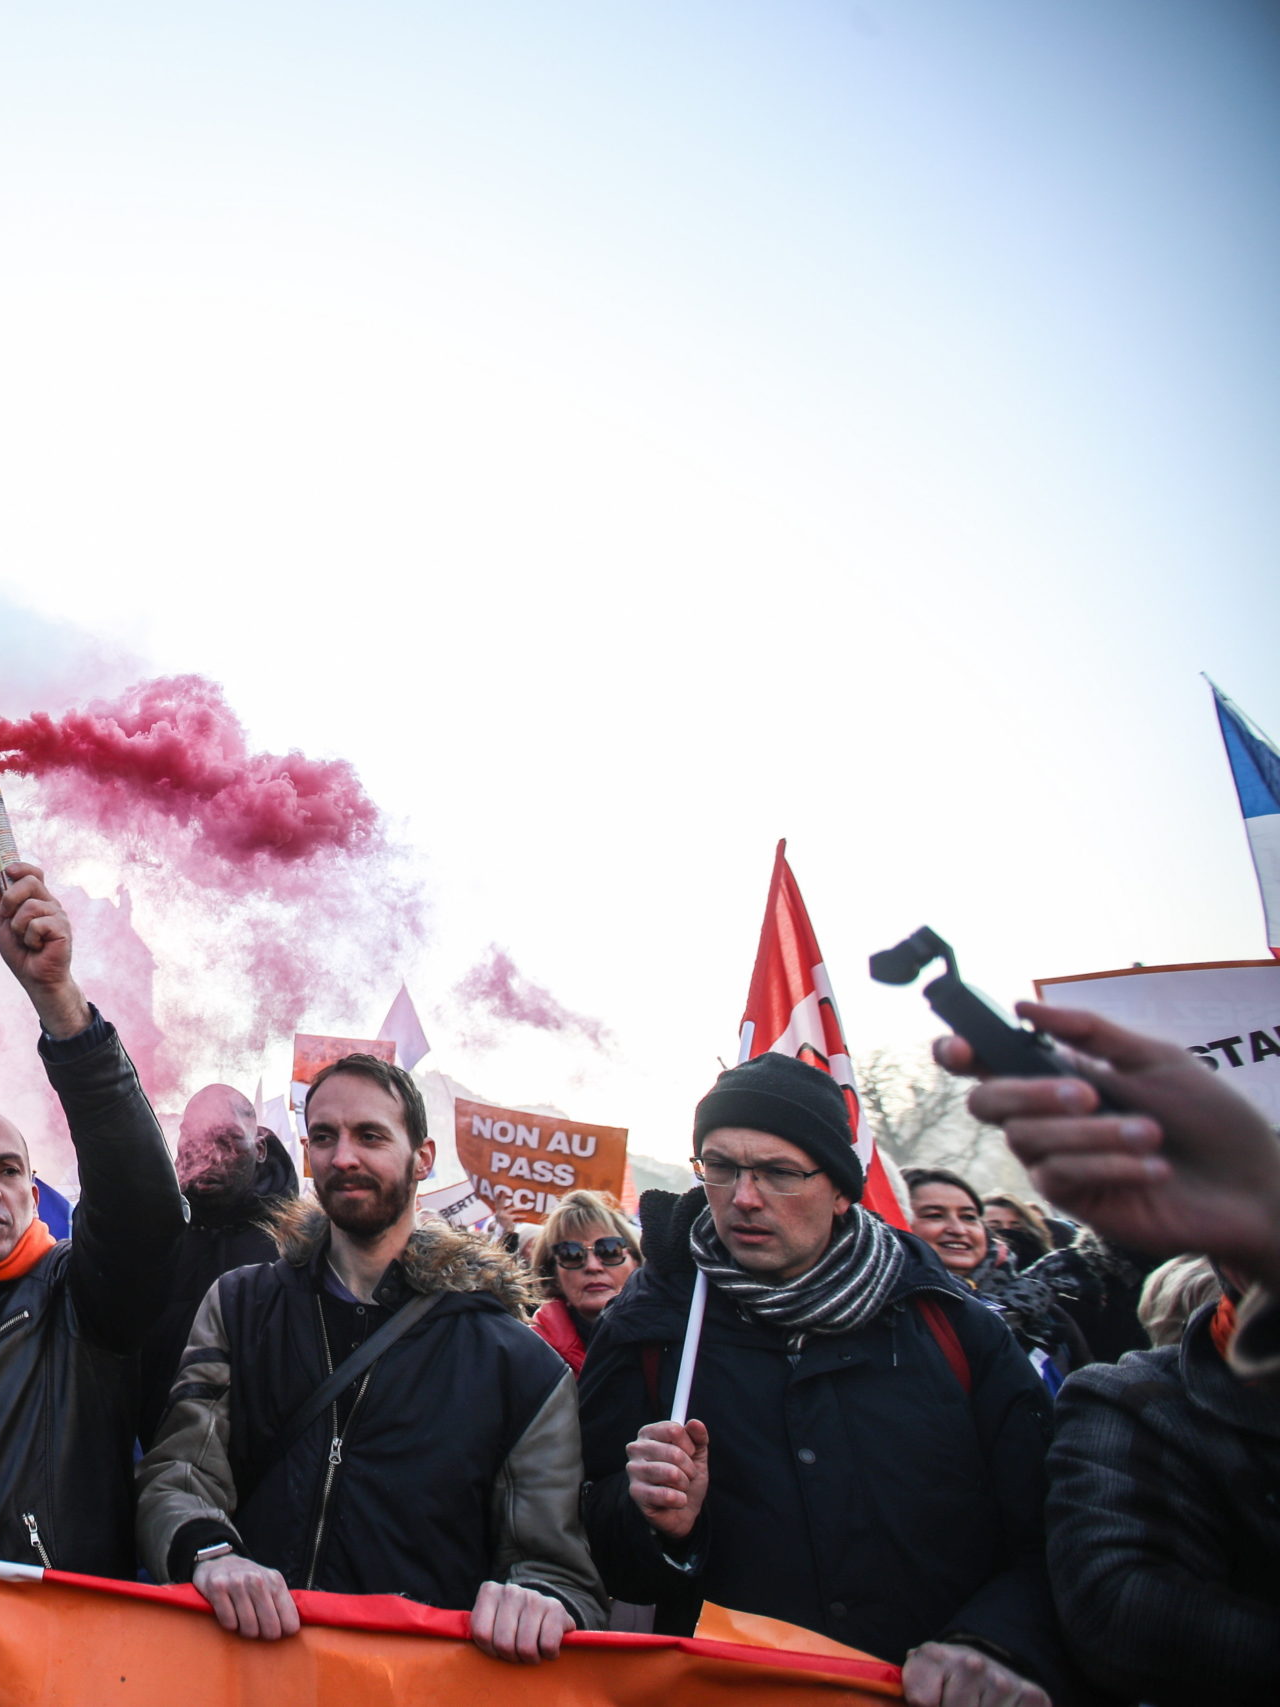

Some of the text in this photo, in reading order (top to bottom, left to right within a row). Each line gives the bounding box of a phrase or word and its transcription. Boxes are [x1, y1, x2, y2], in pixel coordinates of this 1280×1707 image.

[1186, 1025, 1280, 1072] STA
[471, 1114, 597, 1158] NON AU
[491, 1152, 575, 1187] PASS
